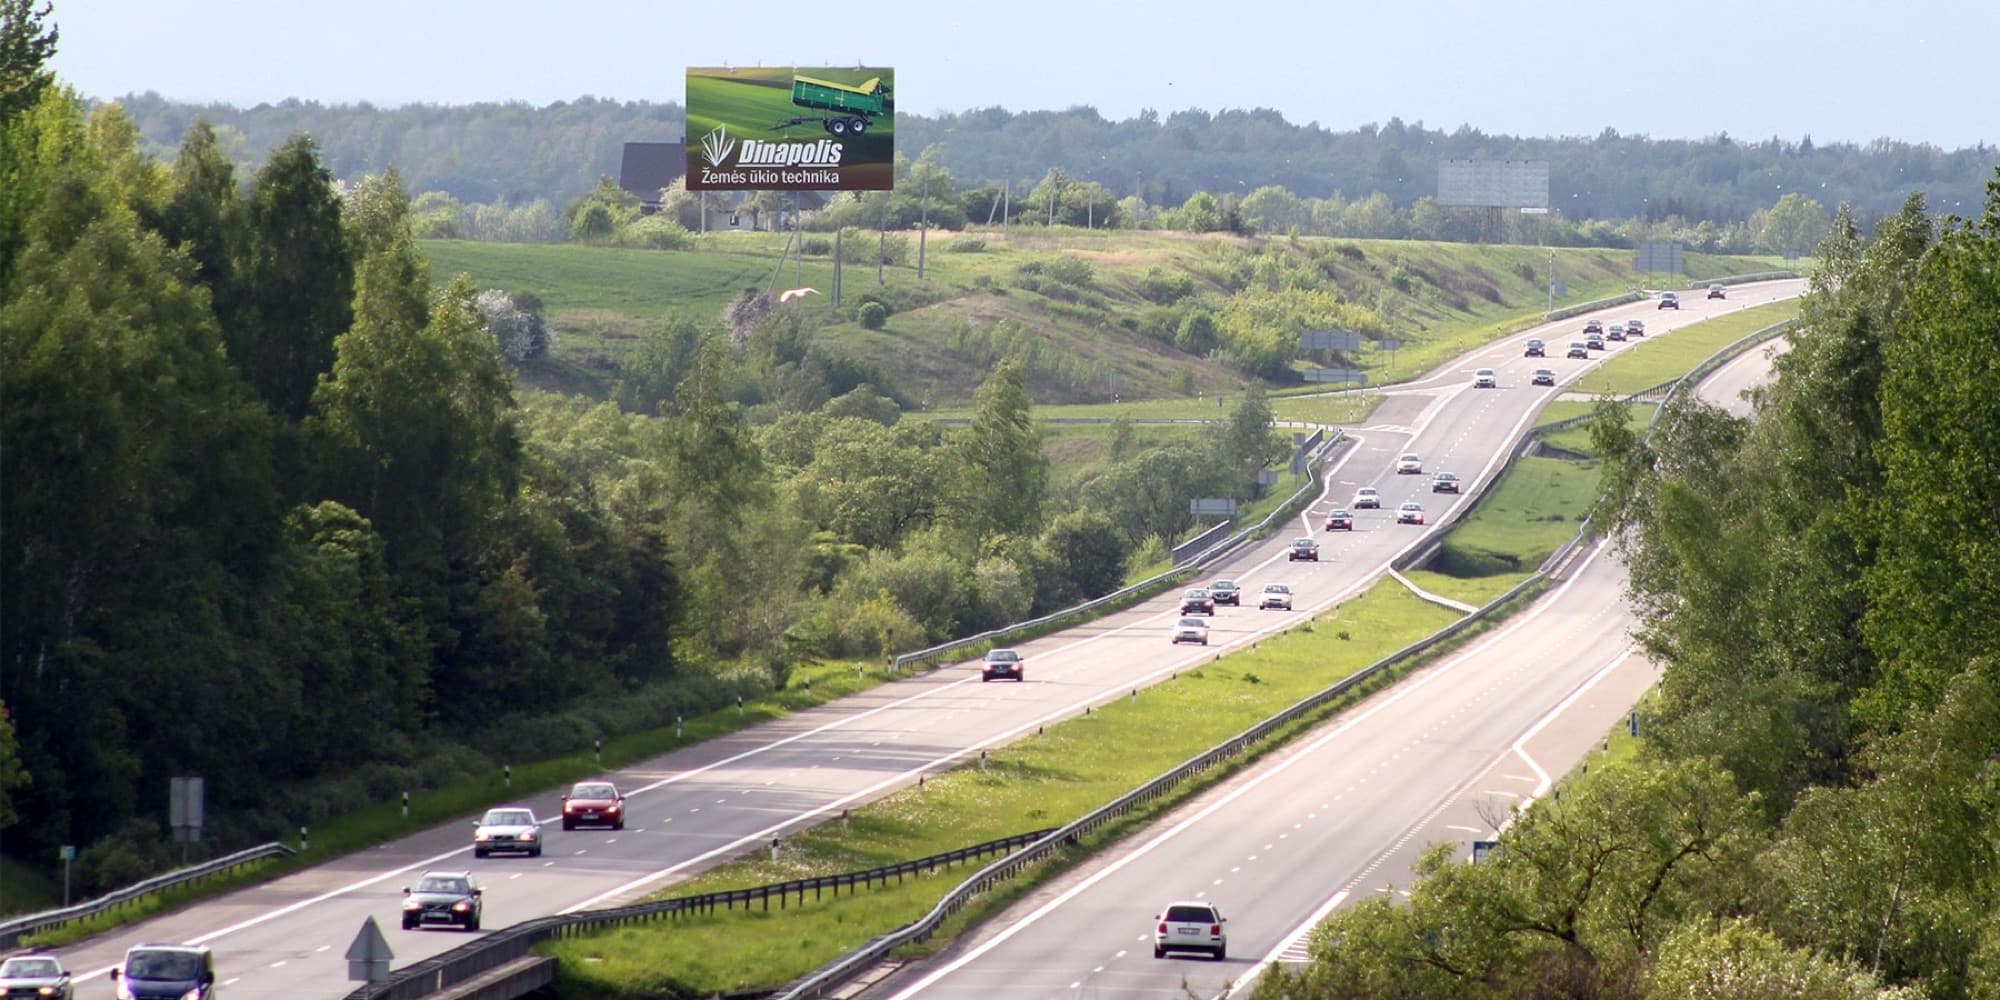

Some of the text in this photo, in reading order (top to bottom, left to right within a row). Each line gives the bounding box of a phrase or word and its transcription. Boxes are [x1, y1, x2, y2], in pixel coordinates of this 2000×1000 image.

[738, 139, 843, 166] Dinapolis
[701, 167, 839, 184] Žemės ūkio technika
